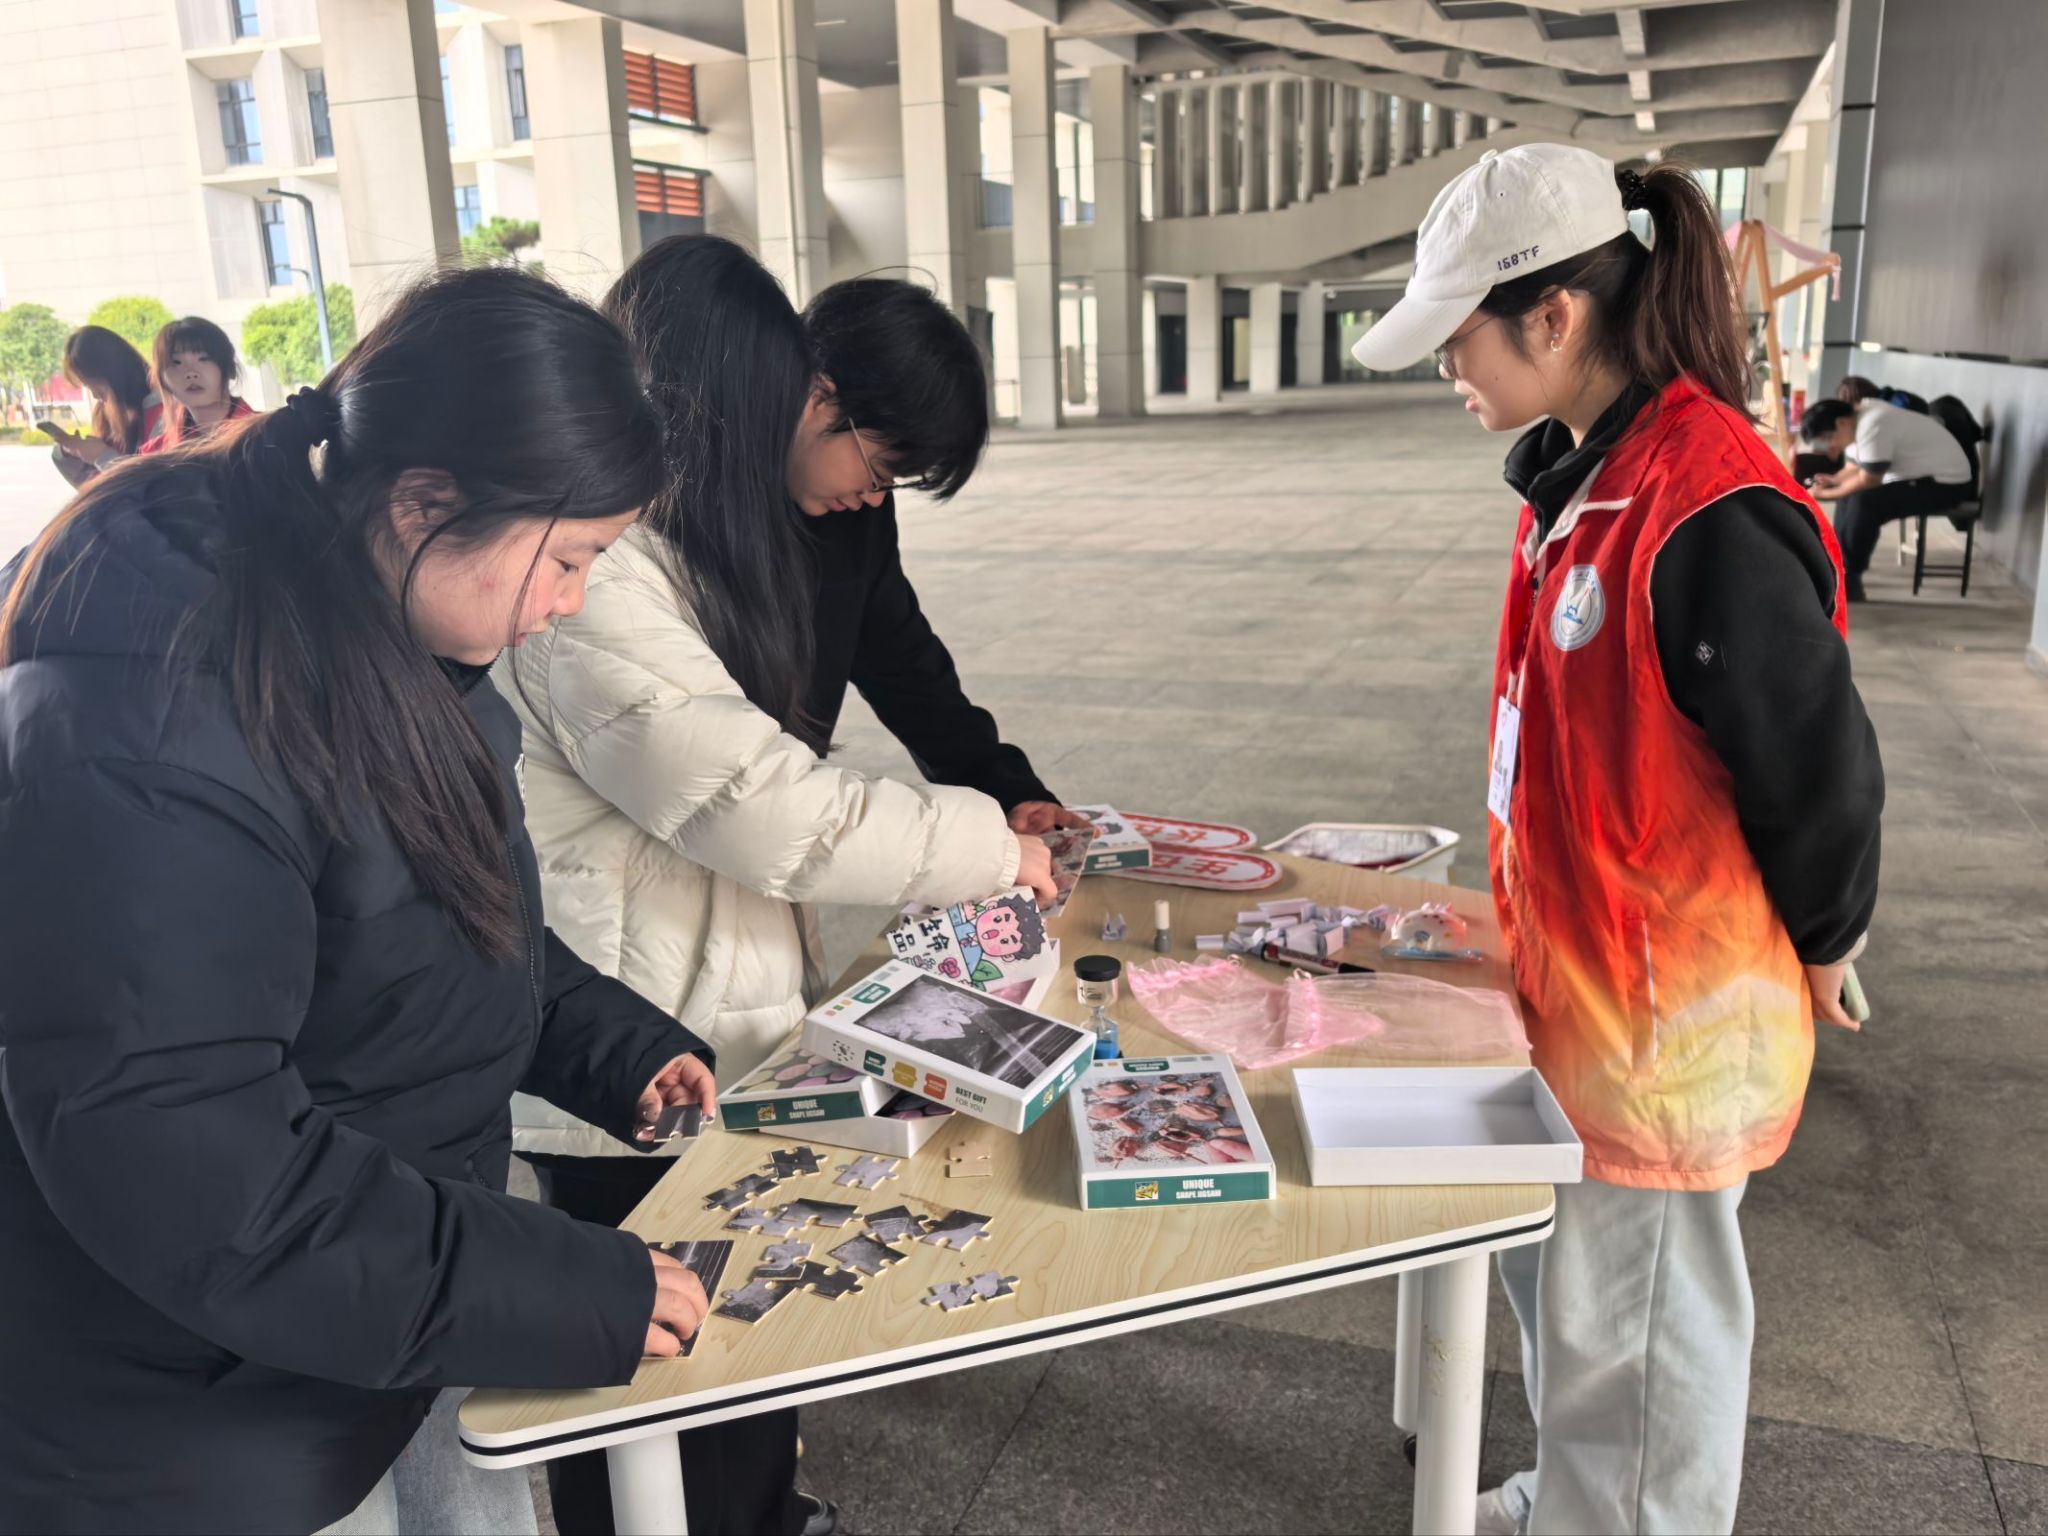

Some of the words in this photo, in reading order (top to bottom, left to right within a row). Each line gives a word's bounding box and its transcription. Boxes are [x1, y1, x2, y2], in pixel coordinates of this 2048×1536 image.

[919, 918, 950, 952] 生命
[955, 1086, 972, 1098] BEST
[972, 1091, 987, 1104] GIFT
[955, 1097, 969, 1106] FOR
[969, 1101, 984, 1113] YOU
[1182, 1178, 1215, 1190] UNIQUE
